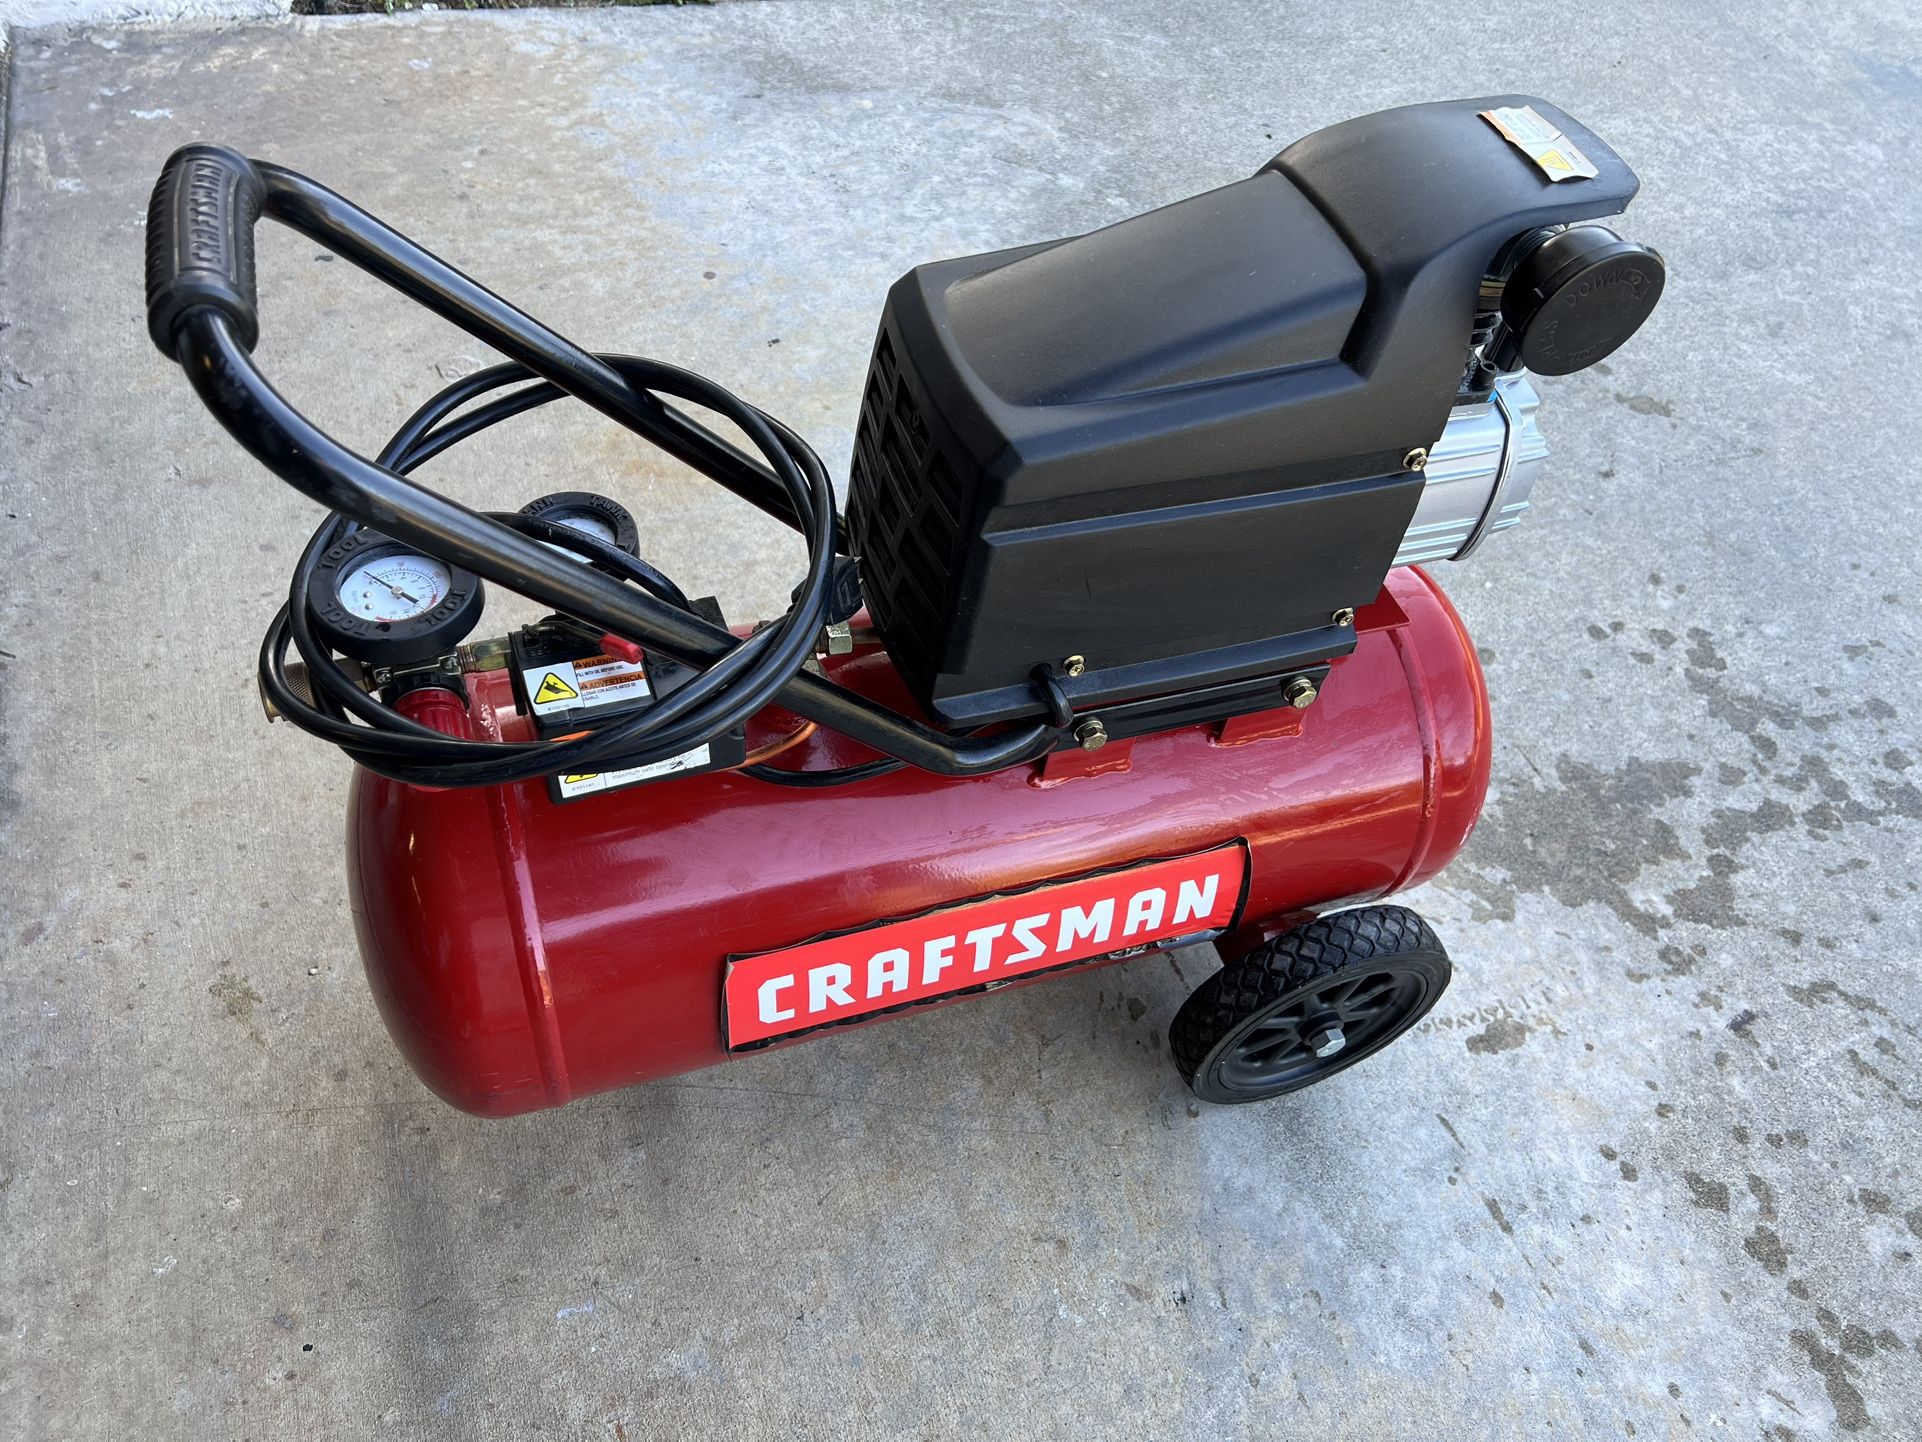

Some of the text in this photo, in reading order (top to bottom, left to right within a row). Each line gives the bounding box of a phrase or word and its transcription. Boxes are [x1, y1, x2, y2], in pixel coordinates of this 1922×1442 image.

[190, 163, 224, 265] CRAFTSMAN
[1564, 269, 1626, 308] DOWN
[590, 495, 630, 523] TANK
[317, 532, 370, 571] TOOL
[320, 601, 372, 637] TOOL
[418, 588, 469, 628] TOOL
[589, 673, 643, 689] ADVERTENCIA
[612, 770, 640, 779] maximum
[641, 765, 655, 774] safe
[757, 874, 1220, 1024] CRAFTSMAN
